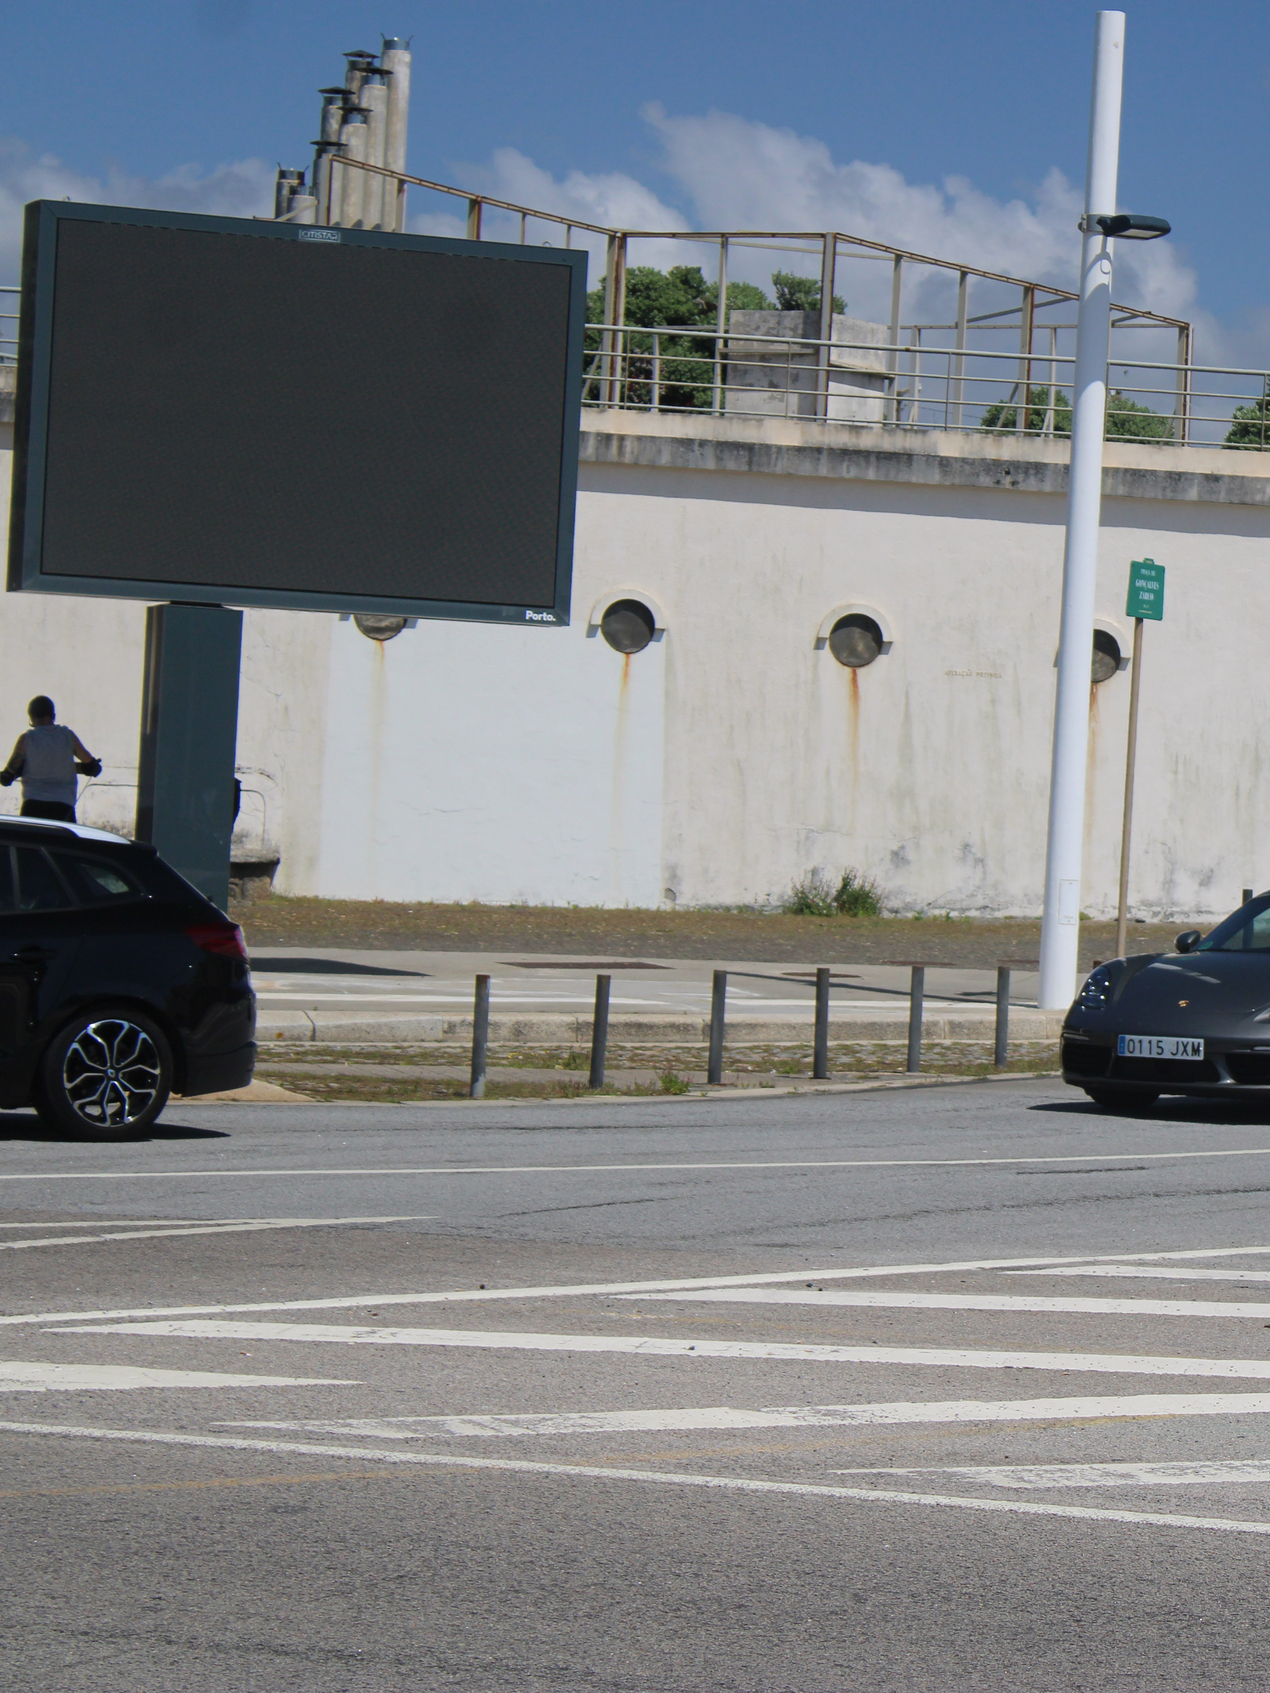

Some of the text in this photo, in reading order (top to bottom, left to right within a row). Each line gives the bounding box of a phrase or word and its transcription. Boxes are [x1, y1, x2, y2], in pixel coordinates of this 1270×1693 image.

[1138, 591, 1155, 601] ZARCO
[525, 610, 557, 621] Porto.
[1127, 1039, 1201, 1057] 0115 JXM
